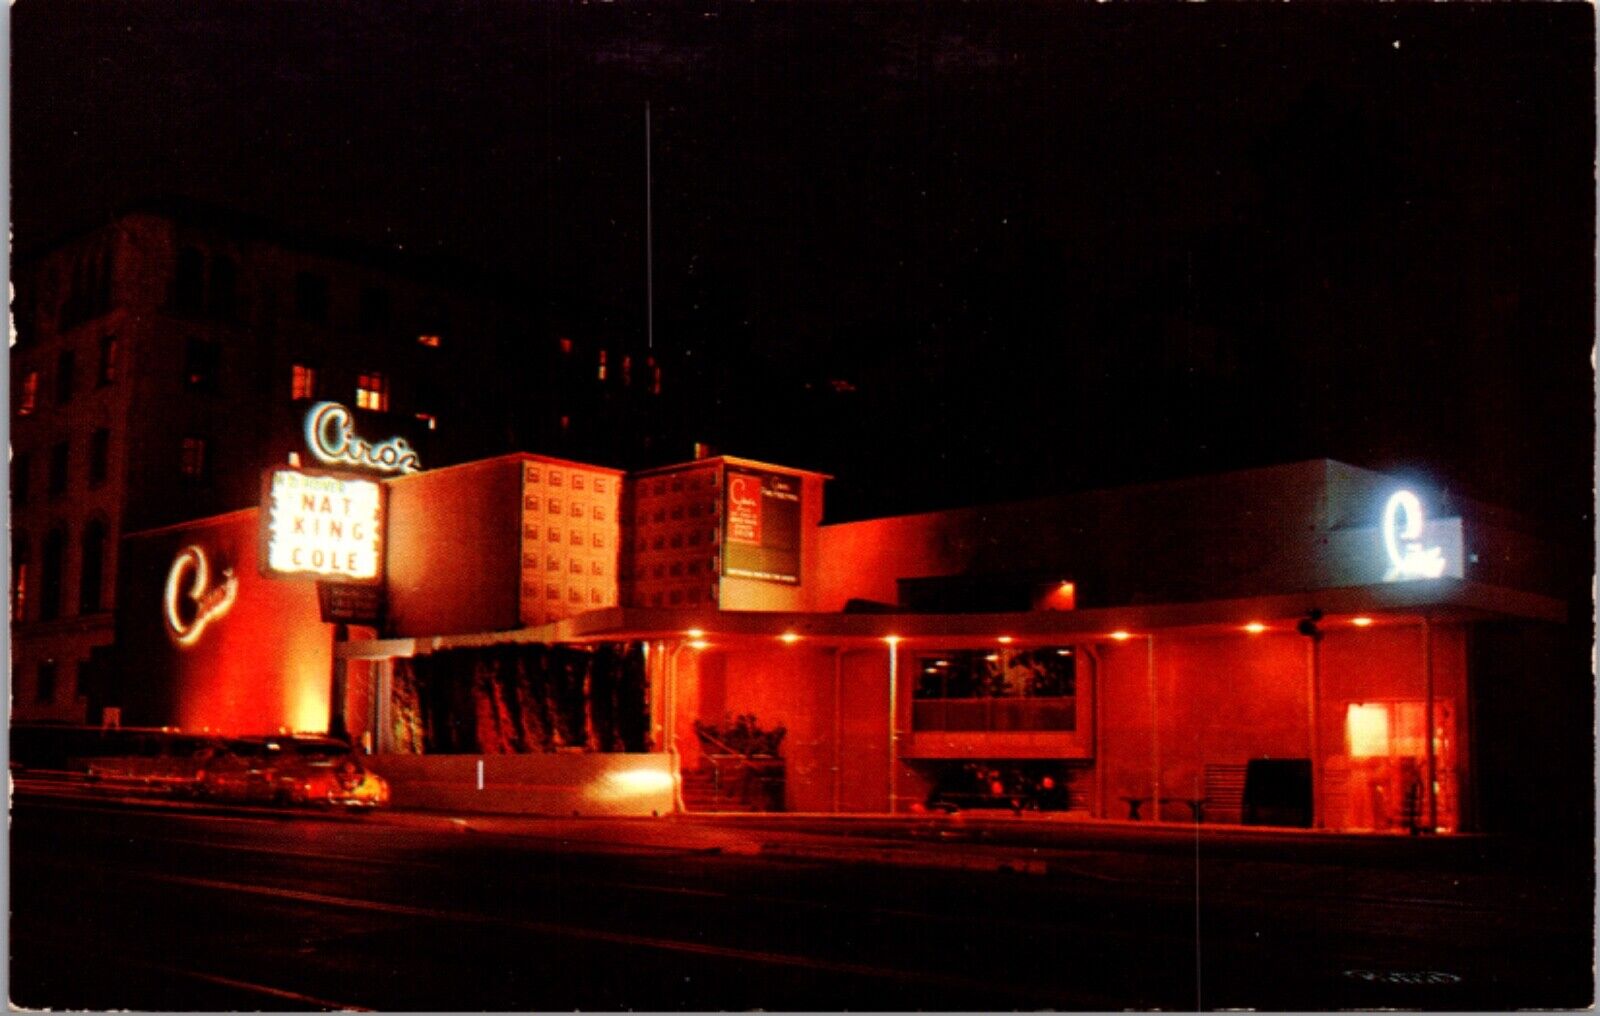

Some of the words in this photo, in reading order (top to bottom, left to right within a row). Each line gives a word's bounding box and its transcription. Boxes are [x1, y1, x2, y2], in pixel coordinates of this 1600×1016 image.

[304, 401, 420, 474] Ciro's
[302, 494, 351, 516] NAT
[293, 515, 364, 541] KING
[291, 547, 358, 571] COLE
